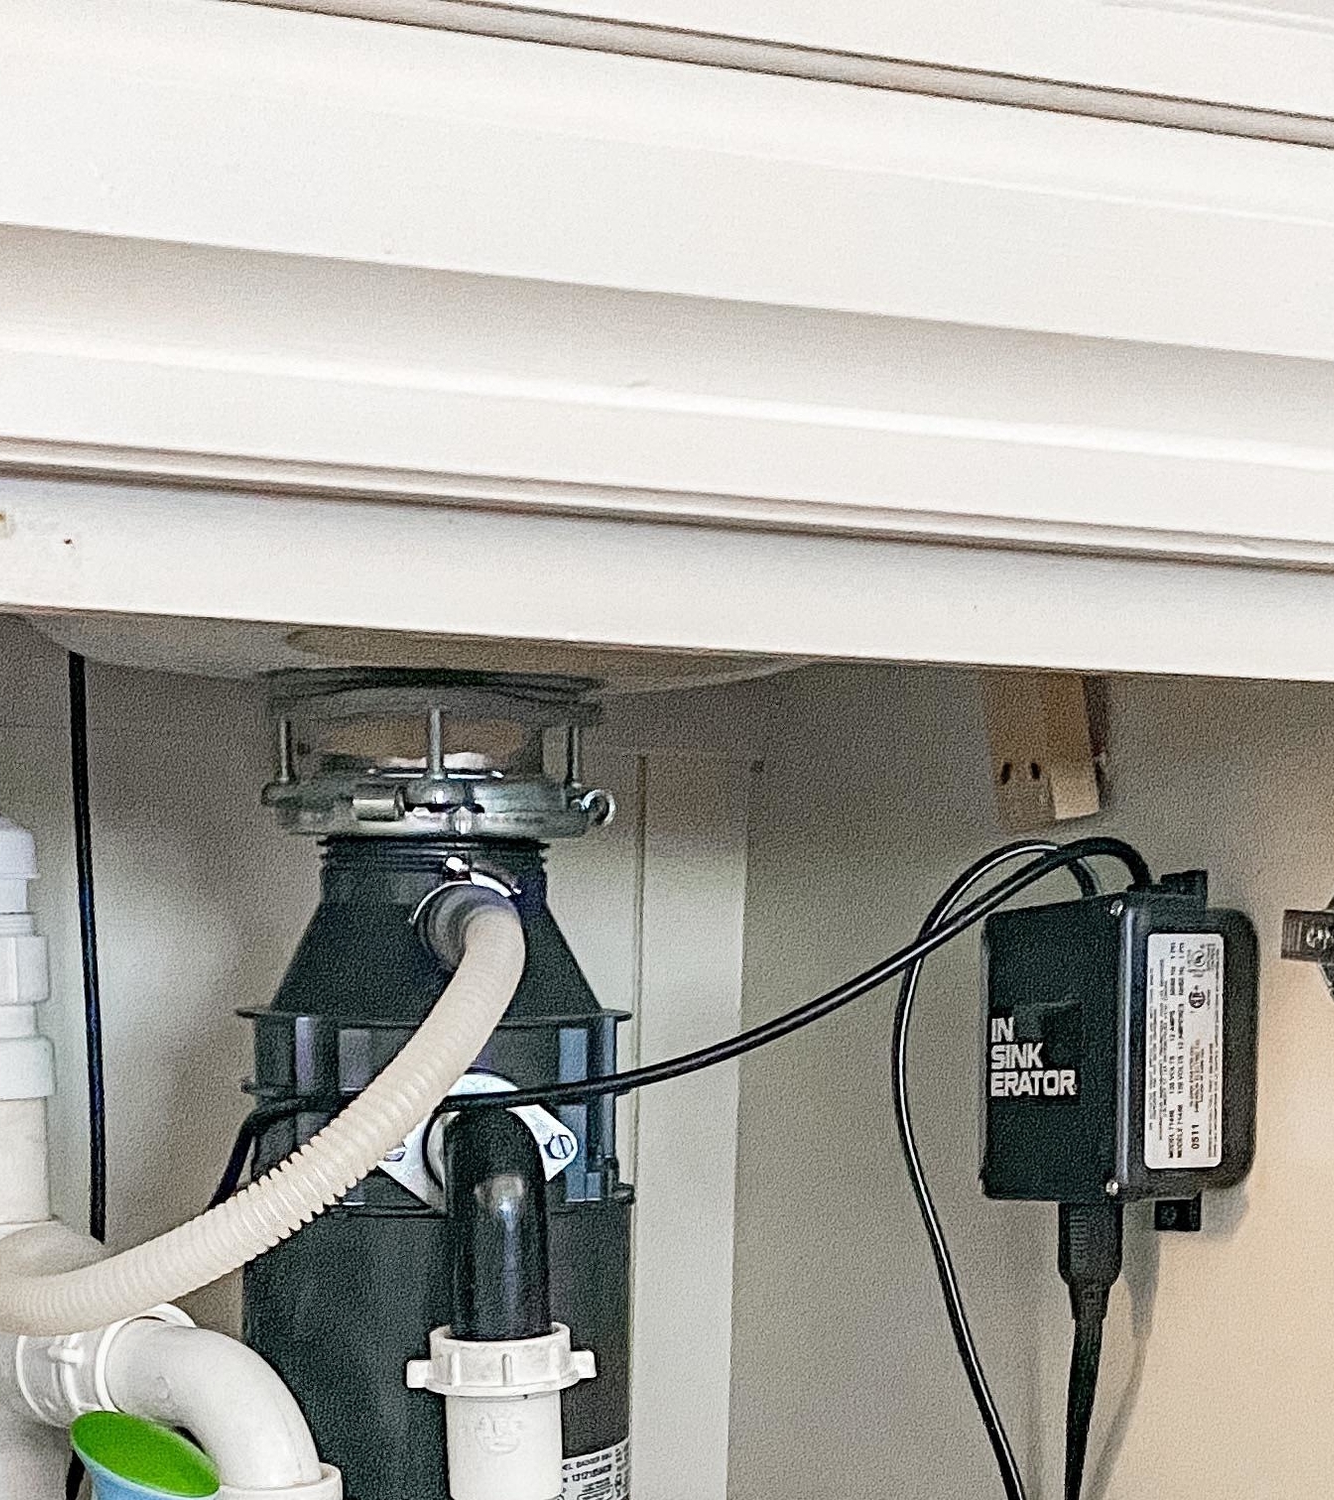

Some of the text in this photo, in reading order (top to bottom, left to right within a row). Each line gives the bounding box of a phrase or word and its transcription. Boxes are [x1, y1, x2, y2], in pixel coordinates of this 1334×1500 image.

[991, 1016, 1014, 1043] IN
[991, 1042, 1043, 1070] SINK
[990, 1069, 1076, 1097] ERATOR
